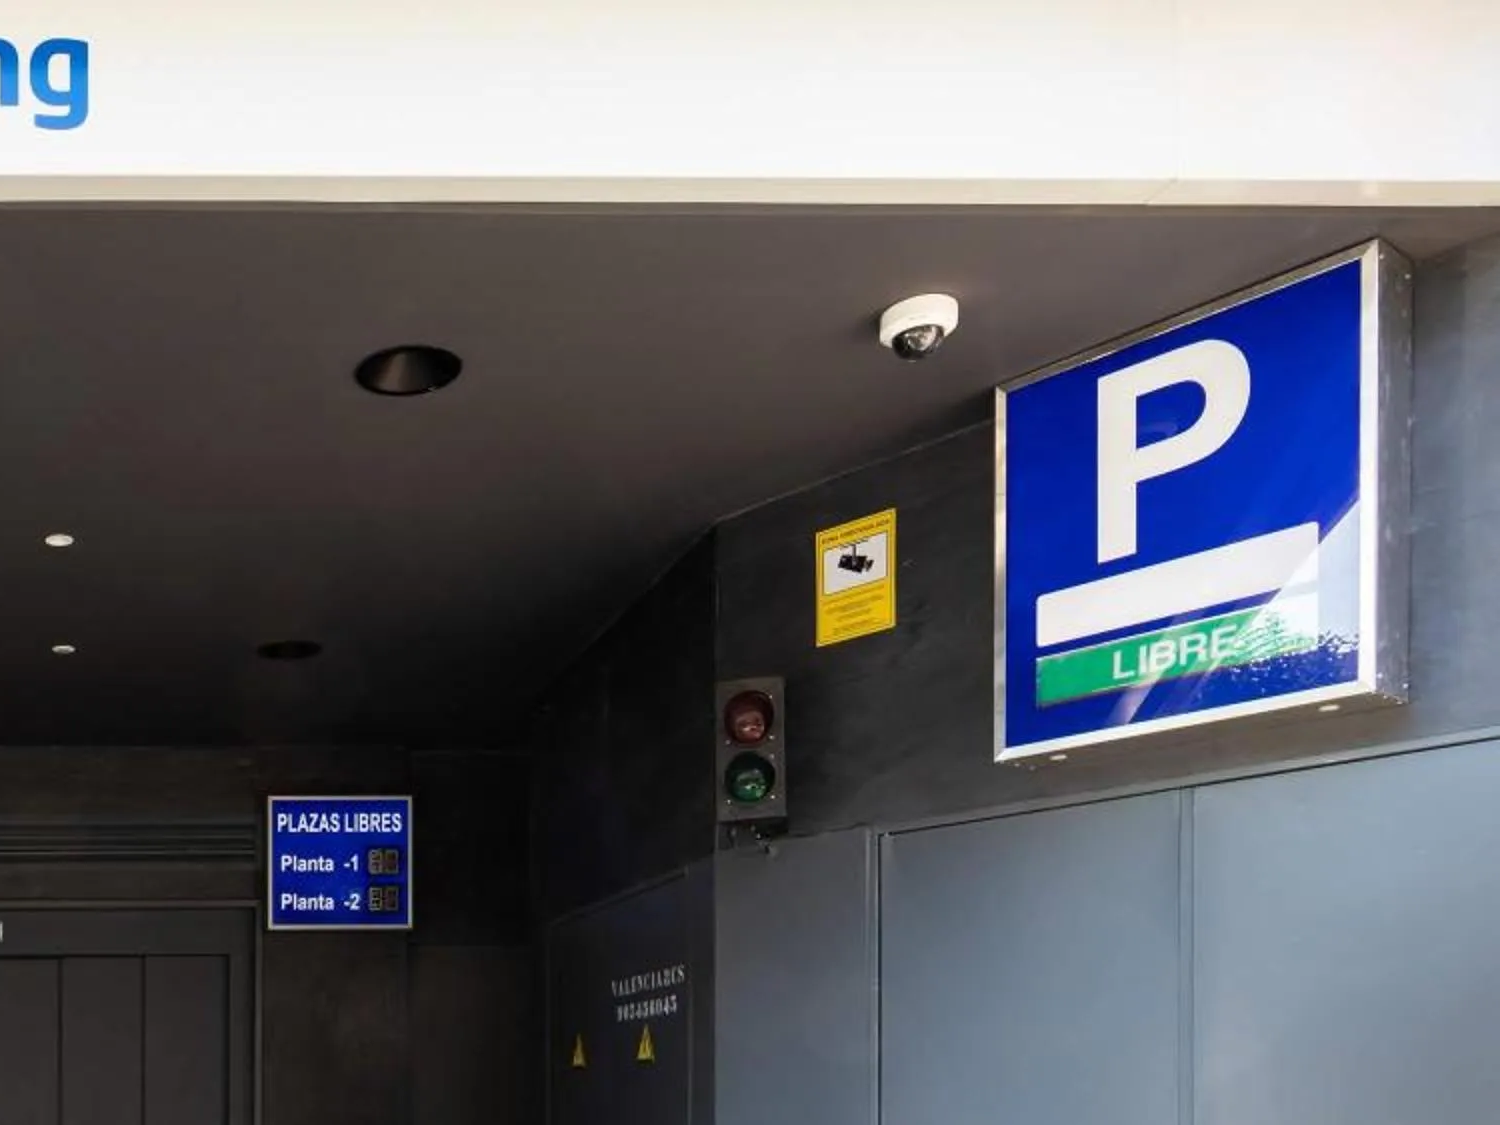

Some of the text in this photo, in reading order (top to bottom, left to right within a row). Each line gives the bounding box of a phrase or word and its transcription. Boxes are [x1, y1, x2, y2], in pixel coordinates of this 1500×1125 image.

[1097, 338, 1251, 565] P
[277, 813, 402, 833] PLAZAS LIBRES
[280, 855, 359, 872] Planta -1
[280, 893, 361, 911] Planta -2
